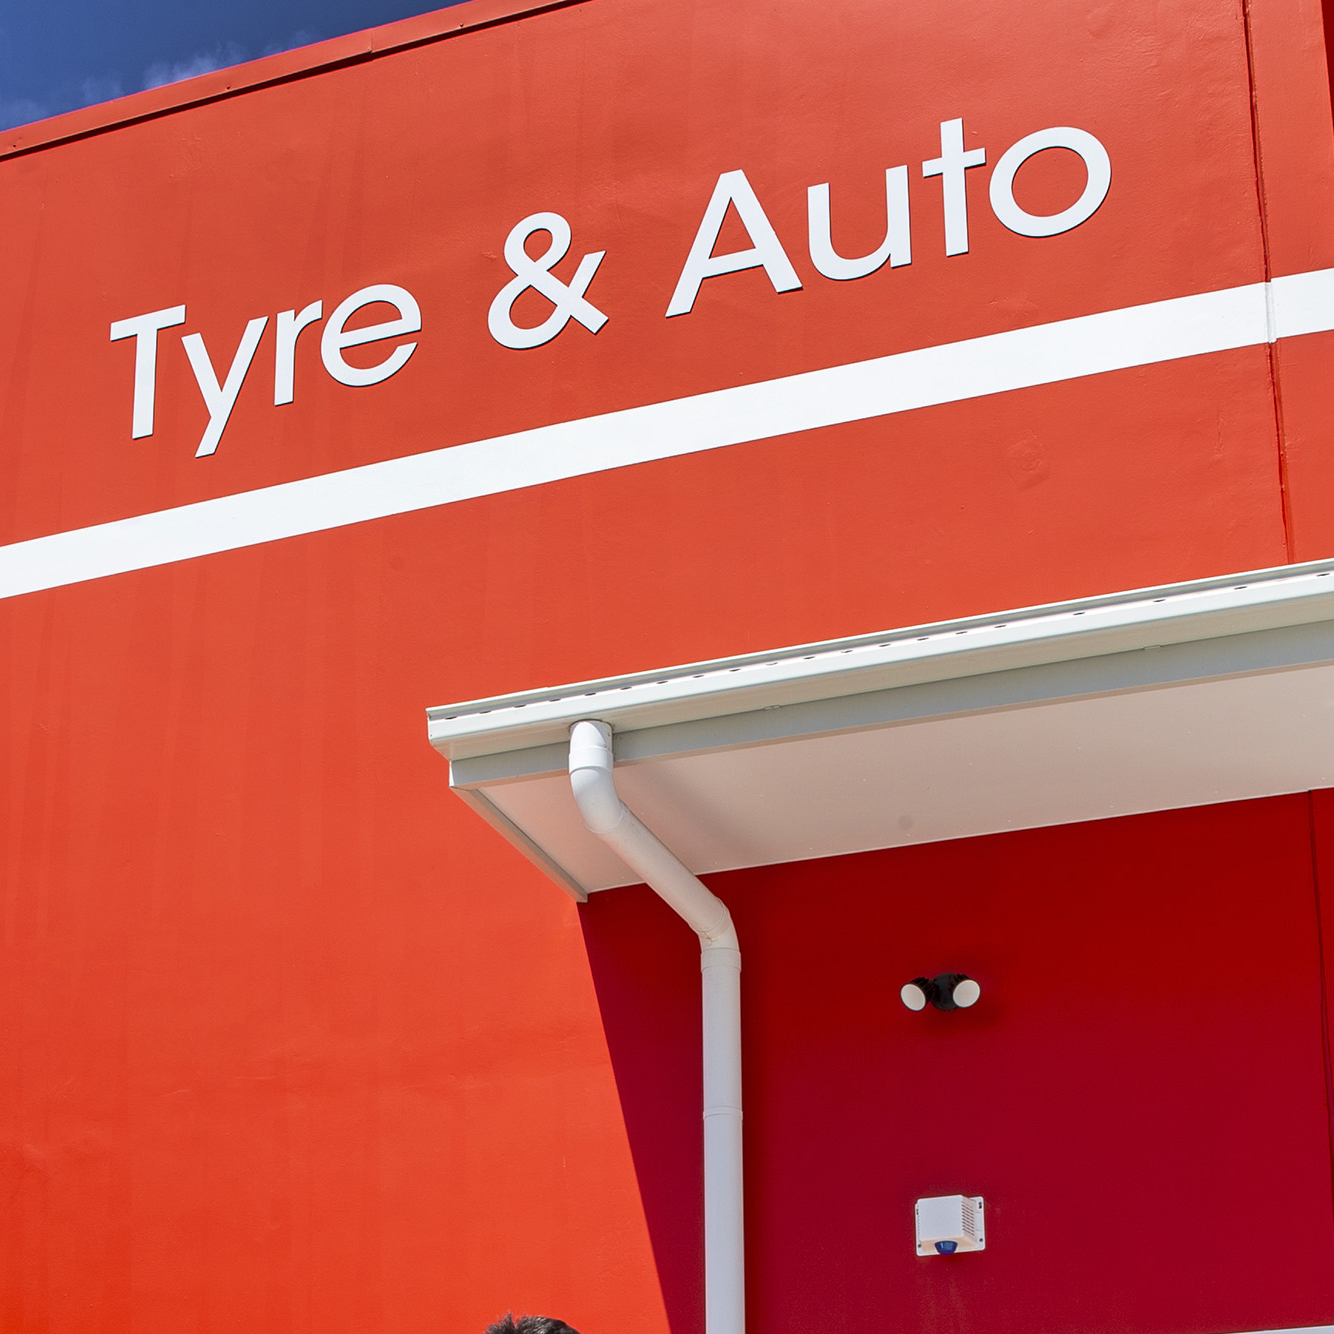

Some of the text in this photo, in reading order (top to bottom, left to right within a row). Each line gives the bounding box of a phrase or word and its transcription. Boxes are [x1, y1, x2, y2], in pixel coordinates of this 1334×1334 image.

[110, 116, 1113, 458] Tyre & Auto
